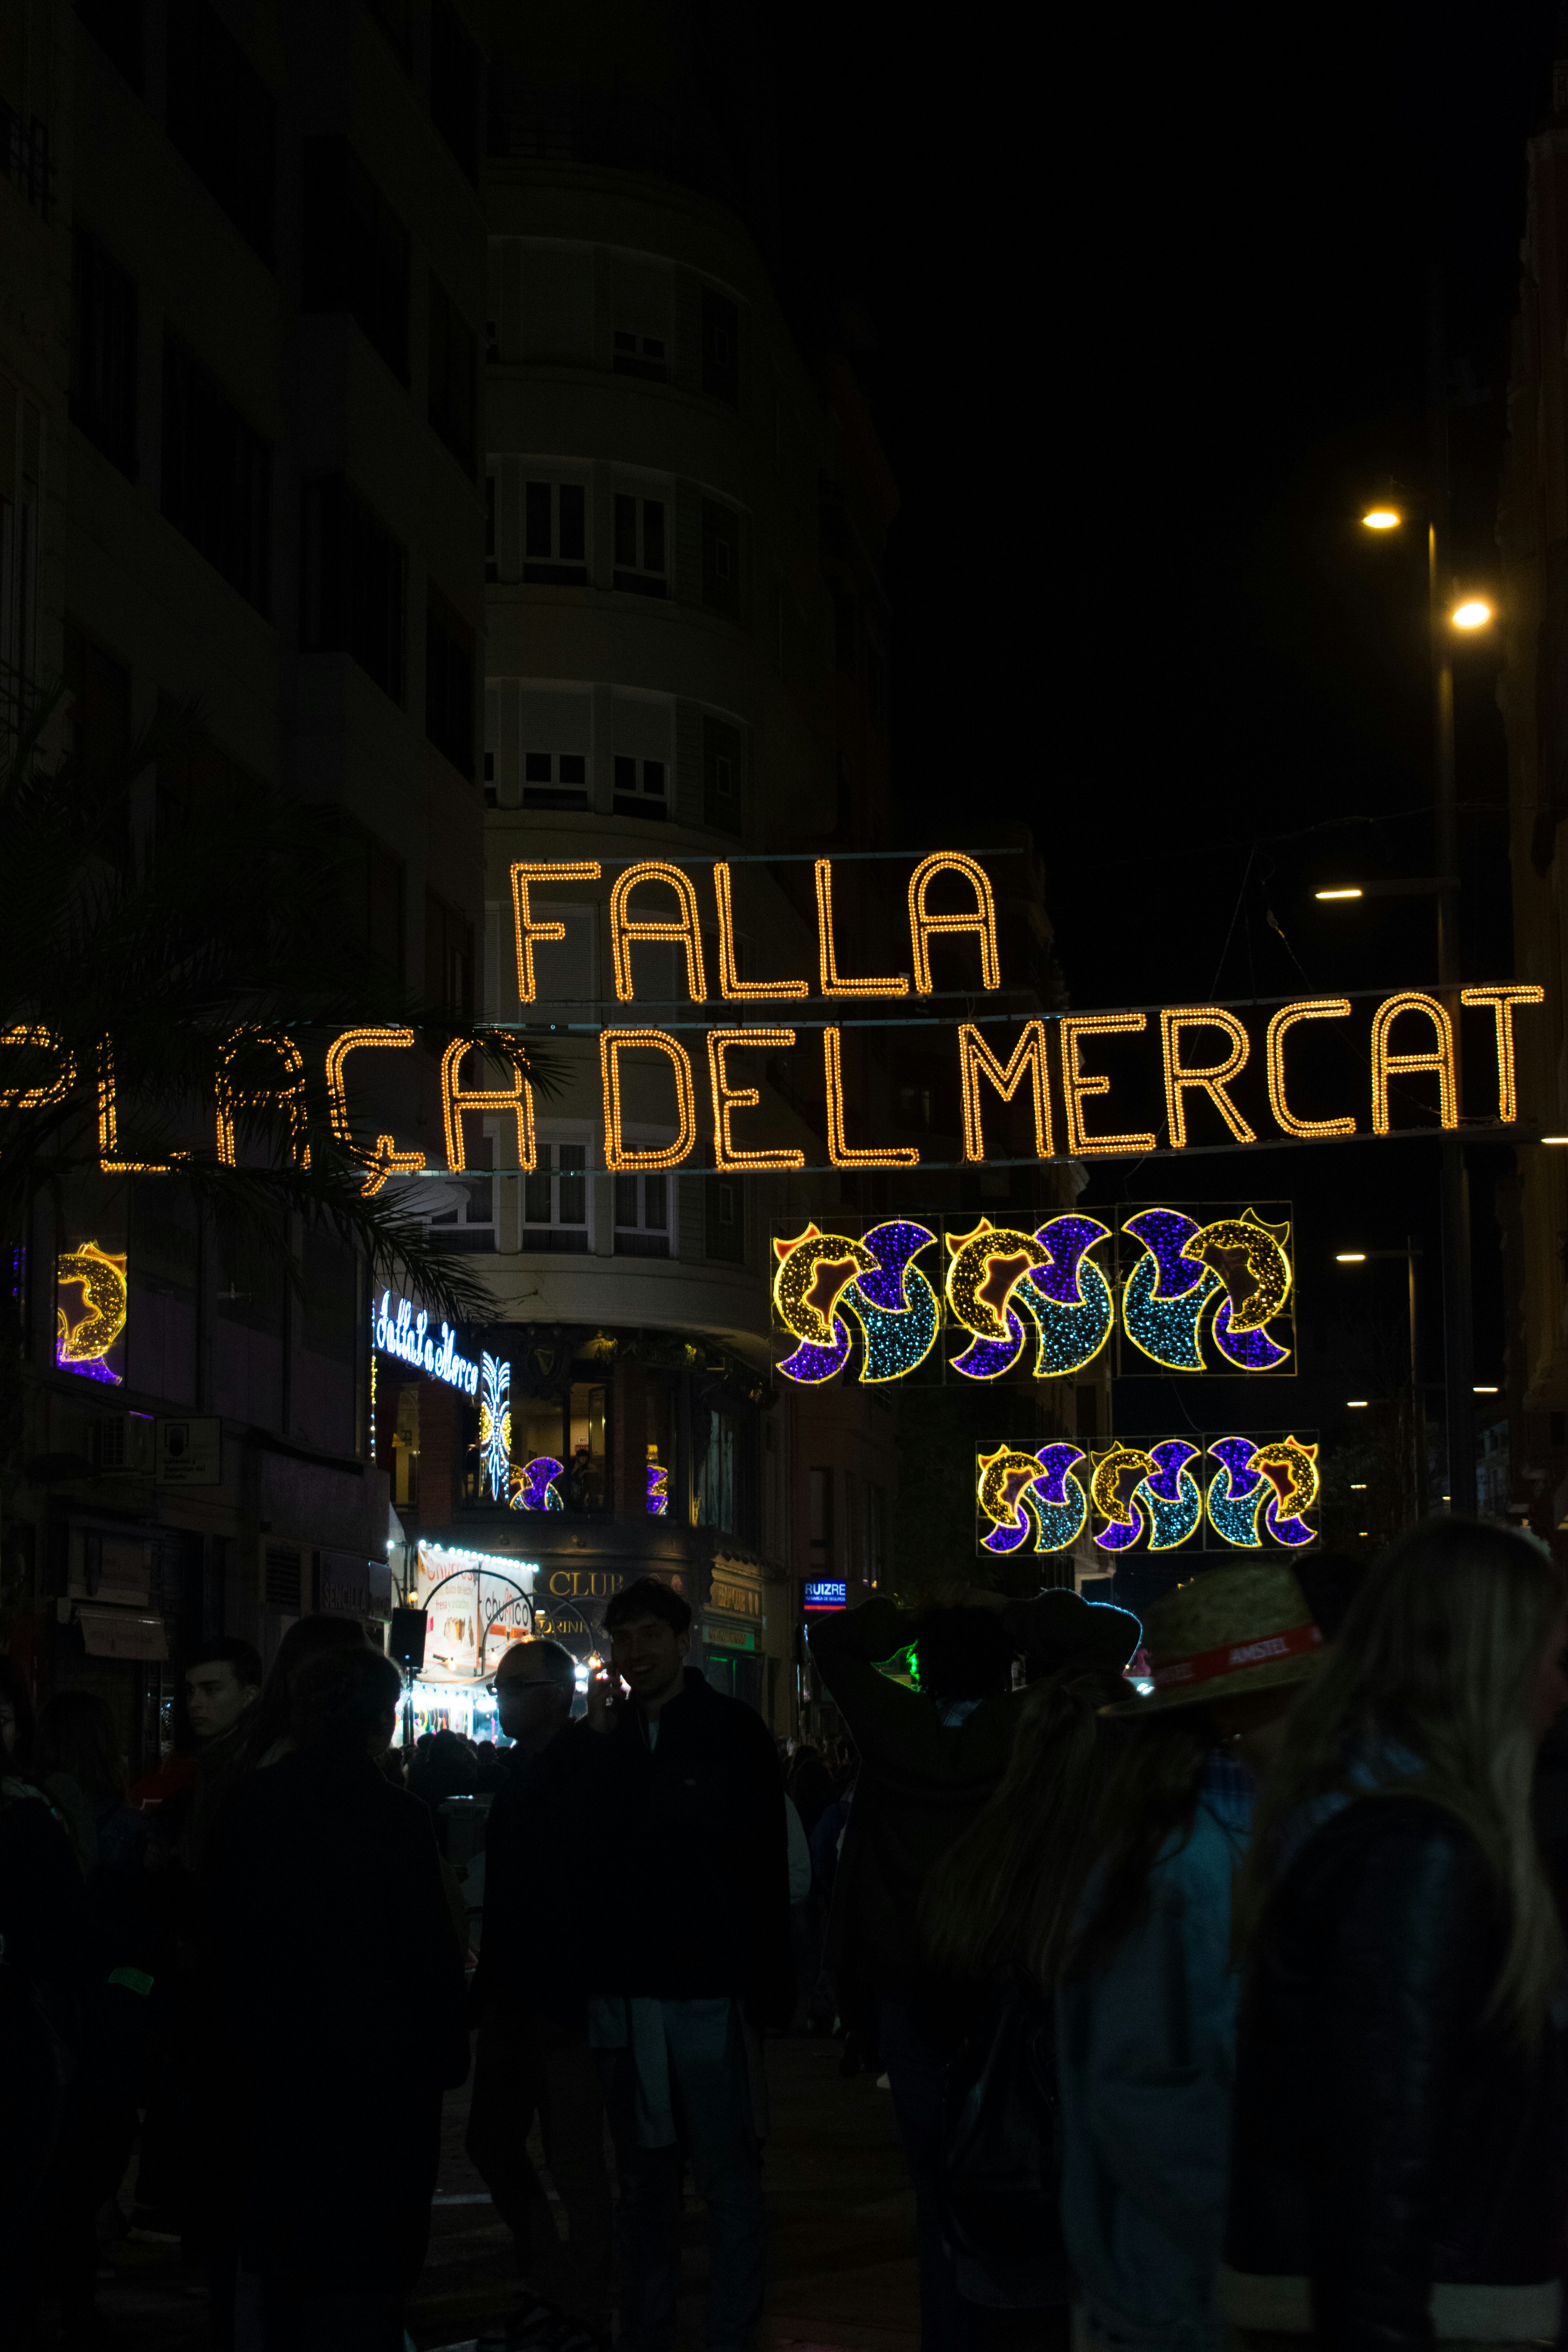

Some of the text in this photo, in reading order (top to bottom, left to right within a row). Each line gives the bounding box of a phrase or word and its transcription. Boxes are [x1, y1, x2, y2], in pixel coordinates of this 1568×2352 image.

[511, 852, 1000, 1002] FALLA
[599, 1027, 919, 1170] DEL
[957, 985, 1544, 1162] MERCAT
[549, 1571, 624, 1596] CLUB
[805, 1583, 846, 1595] RUIZRE
